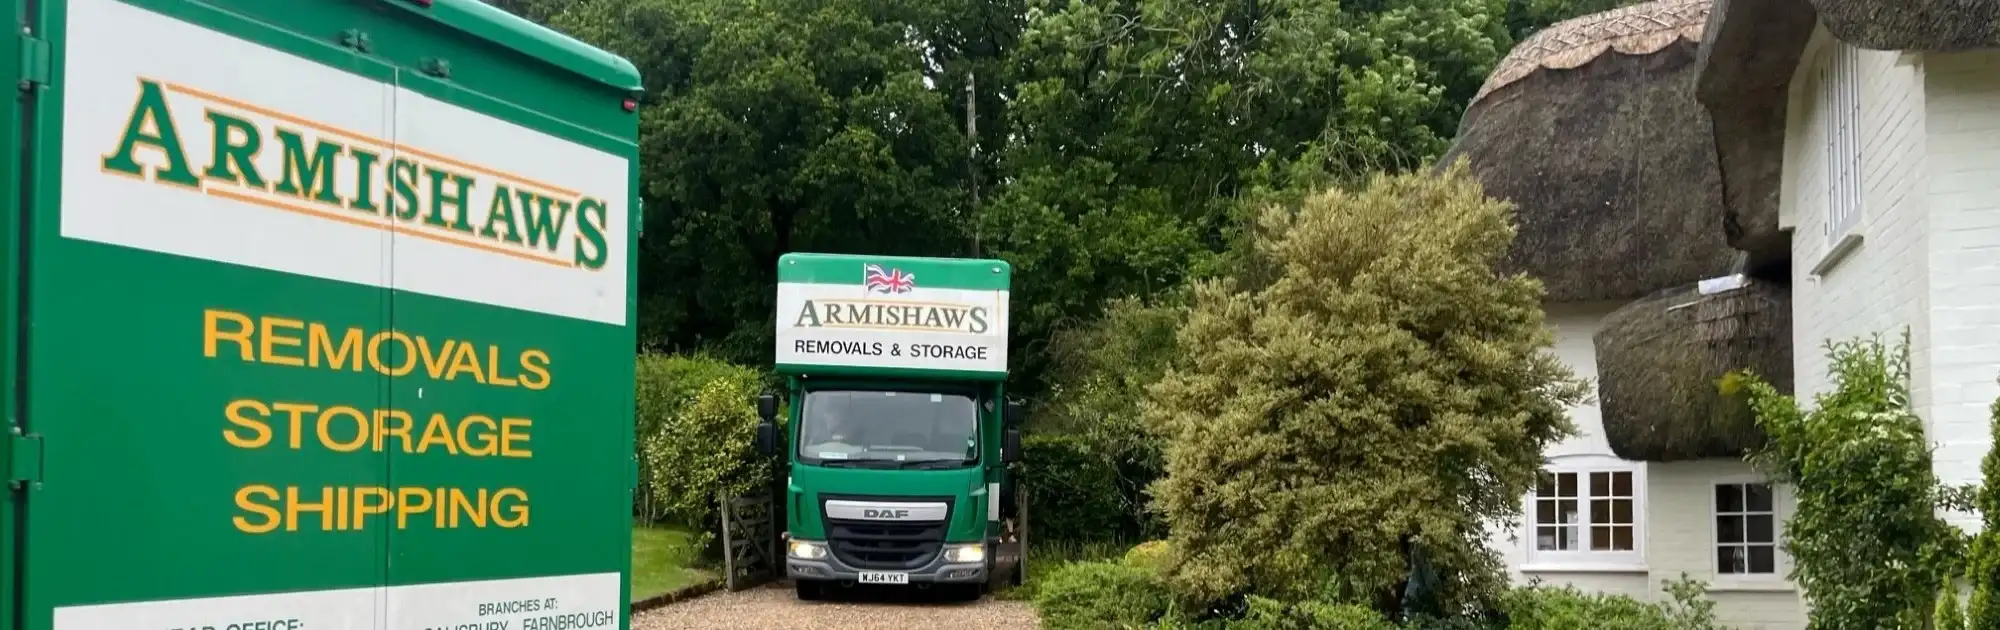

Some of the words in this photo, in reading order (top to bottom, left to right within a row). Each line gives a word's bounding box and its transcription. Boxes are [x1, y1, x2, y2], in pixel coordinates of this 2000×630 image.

[101, 77, 608, 271] ARMISHAWS
[794, 300, 988, 333] ARMISHAWS
[204, 309, 552, 390] REMOVALS
[795, 340, 882, 356] REMOVALS
[891, 343, 901, 357] &
[910, 343, 987, 360] STORAGE
[223, 399, 533, 458] STORAGE
[232, 484, 530, 534] SHIPPING
[864, 509, 909, 519] DAF
[862, 573, 885, 582] WJ64
[888, 574, 905, 583] YKT
[478, 599, 540, 616] BRANCHES
[544, 597, 558, 610] AT:
[523, 610, 614, 630] FARNBROUGH
